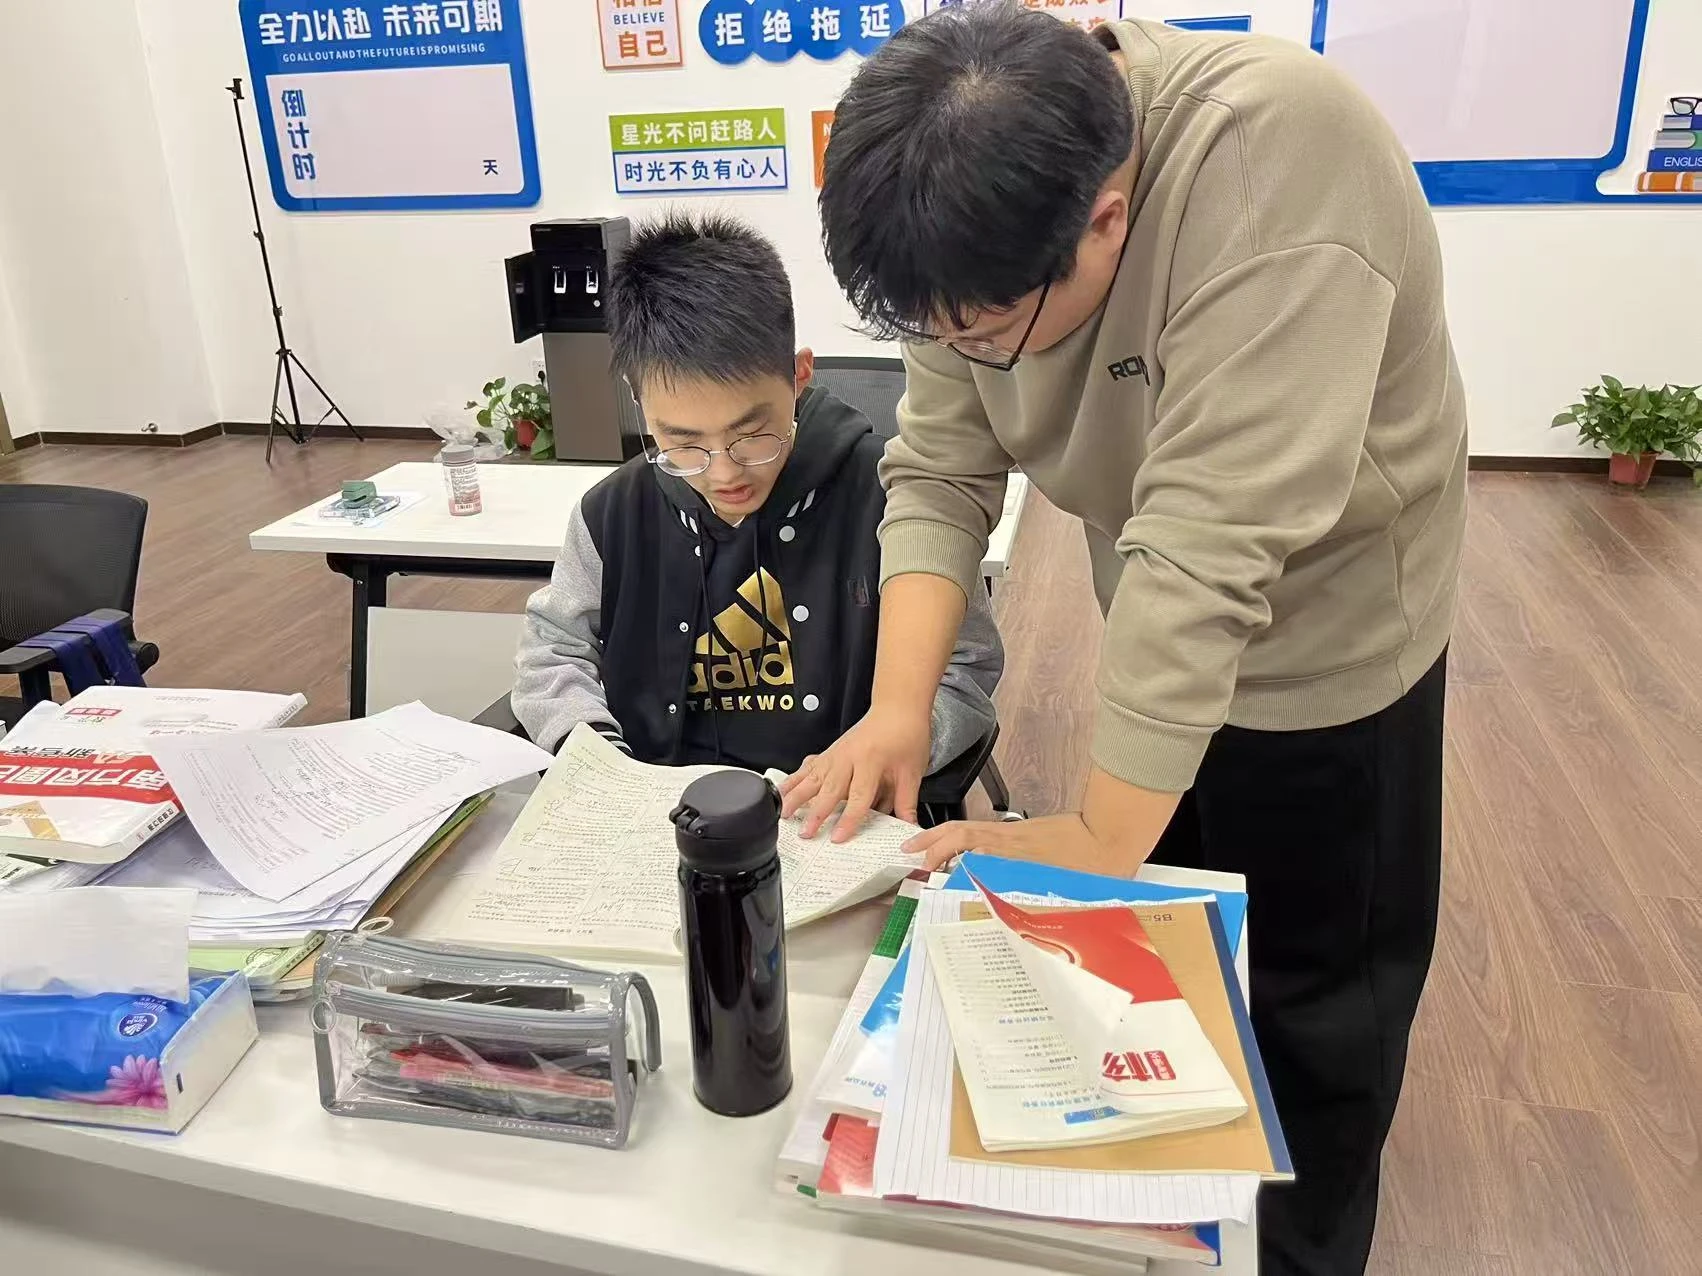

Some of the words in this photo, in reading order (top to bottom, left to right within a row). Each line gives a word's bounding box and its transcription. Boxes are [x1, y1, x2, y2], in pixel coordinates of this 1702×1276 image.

[258, 7, 372, 45] 全力以赴
[382, 0, 503, 37] 未来可期
[613, 12, 665, 25] BELIEVE
[714, 4, 892, 47] 拒绝拖延
[282, 43, 486, 63] GOALLOUTANDTHEFUTUREISPROMISING
[618, 30, 668, 59] 自己
[281, 89, 316, 181] 倒计时
[621, 117, 778, 146] 星光不问赶路人
[482, 159, 499, 176] 天
[624, 156, 779, 183] 时光不负有心人
